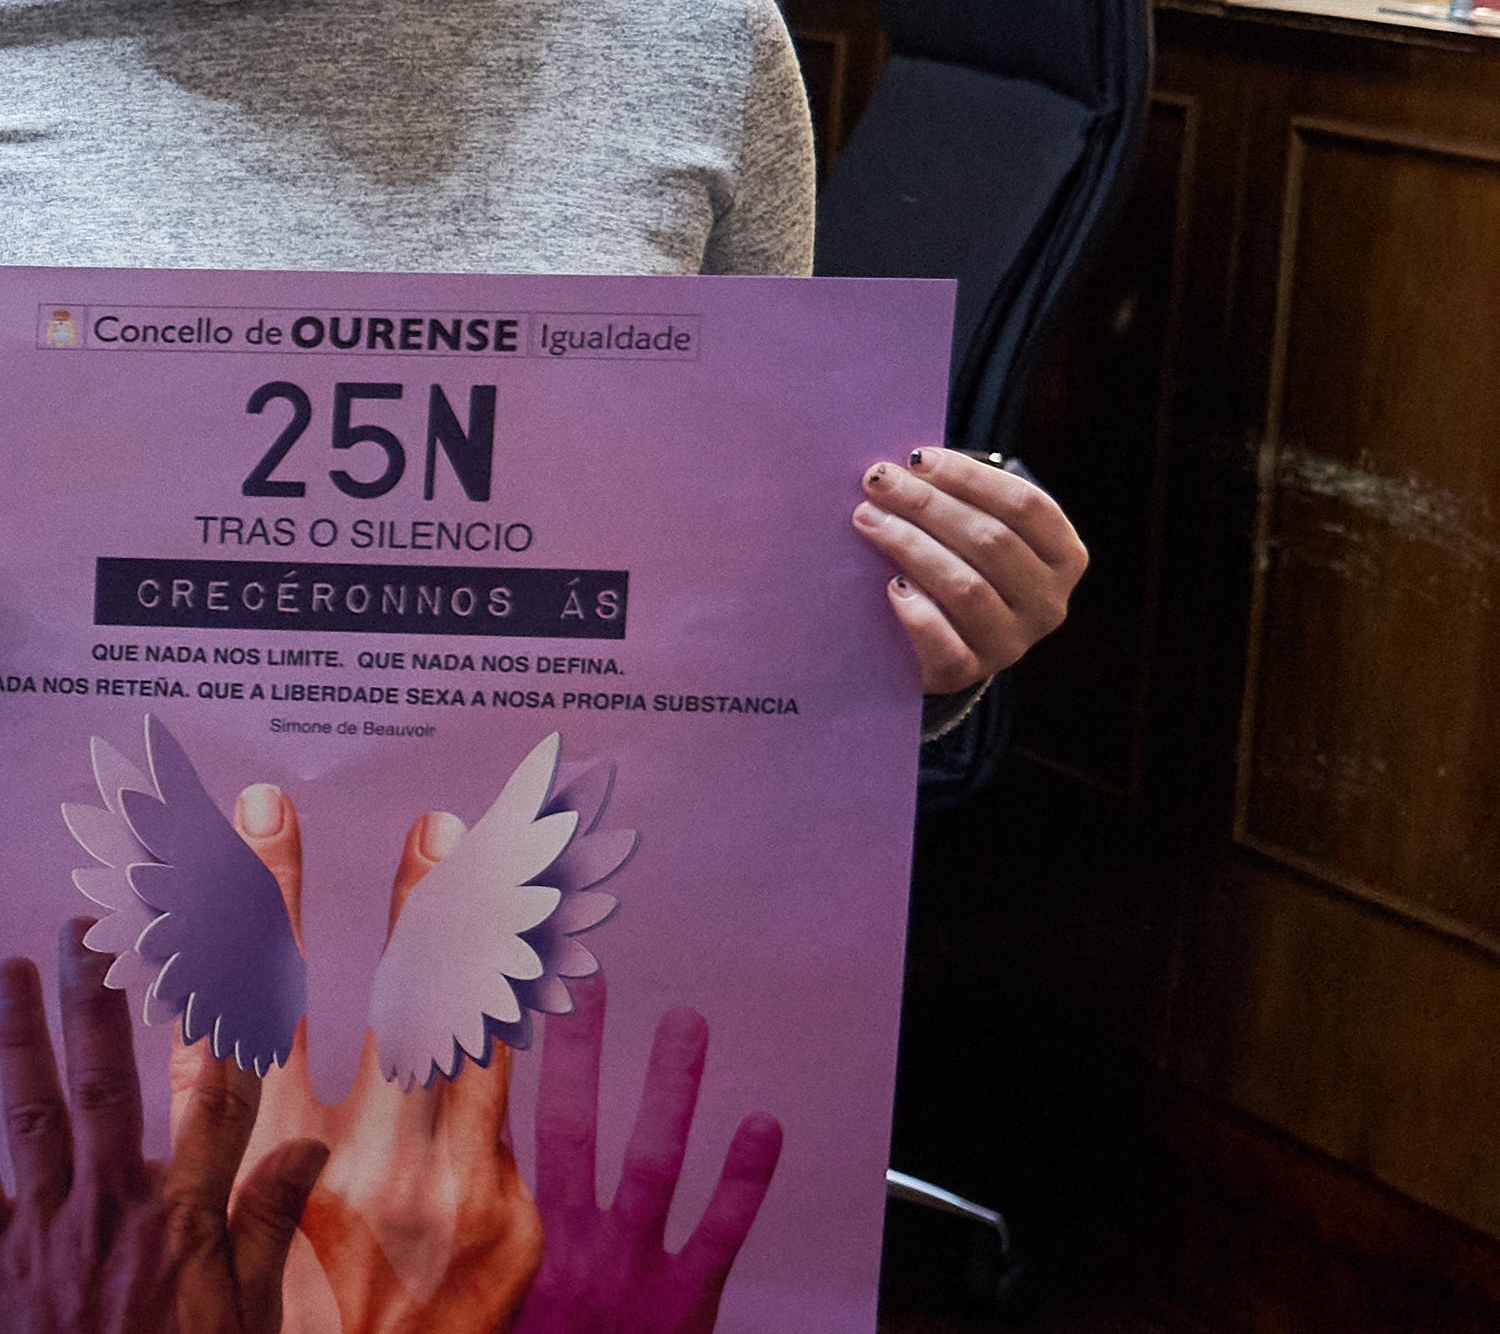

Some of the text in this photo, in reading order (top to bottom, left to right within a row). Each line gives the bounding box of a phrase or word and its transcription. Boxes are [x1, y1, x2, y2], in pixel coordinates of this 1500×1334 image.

[91, 314, 691, 360] Concello de OURENSE Igualdade
[241, 380, 498, 502] 25N
[193, 515, 533, 553] TRAS O SILENCIO
[136, 569, 620, 620] CRECÉRONNOS ÁS
[91, 642, 624, 675] QUE NADA NOS LIMITE. QUE NADA NOS DEFINA.
[42, 676, 89, 695] NOS
[94, 676, 190, 698] RETEÑA.
[196, 680, 244, 700] QUE
[248, 682, 265, 700] A
[270, 683, 399, 705] LIBERDADE
[404, 686, 466, 707] SEXA
[469, 689, 486, 707] A
[491, 689, 555, 709] NOSA
[561, 691, 646, 711] PROPIA
[652, 693, 799, 714] SUBSTANCIA
[268, 717, 436, 738] Simone de Beauvoir
